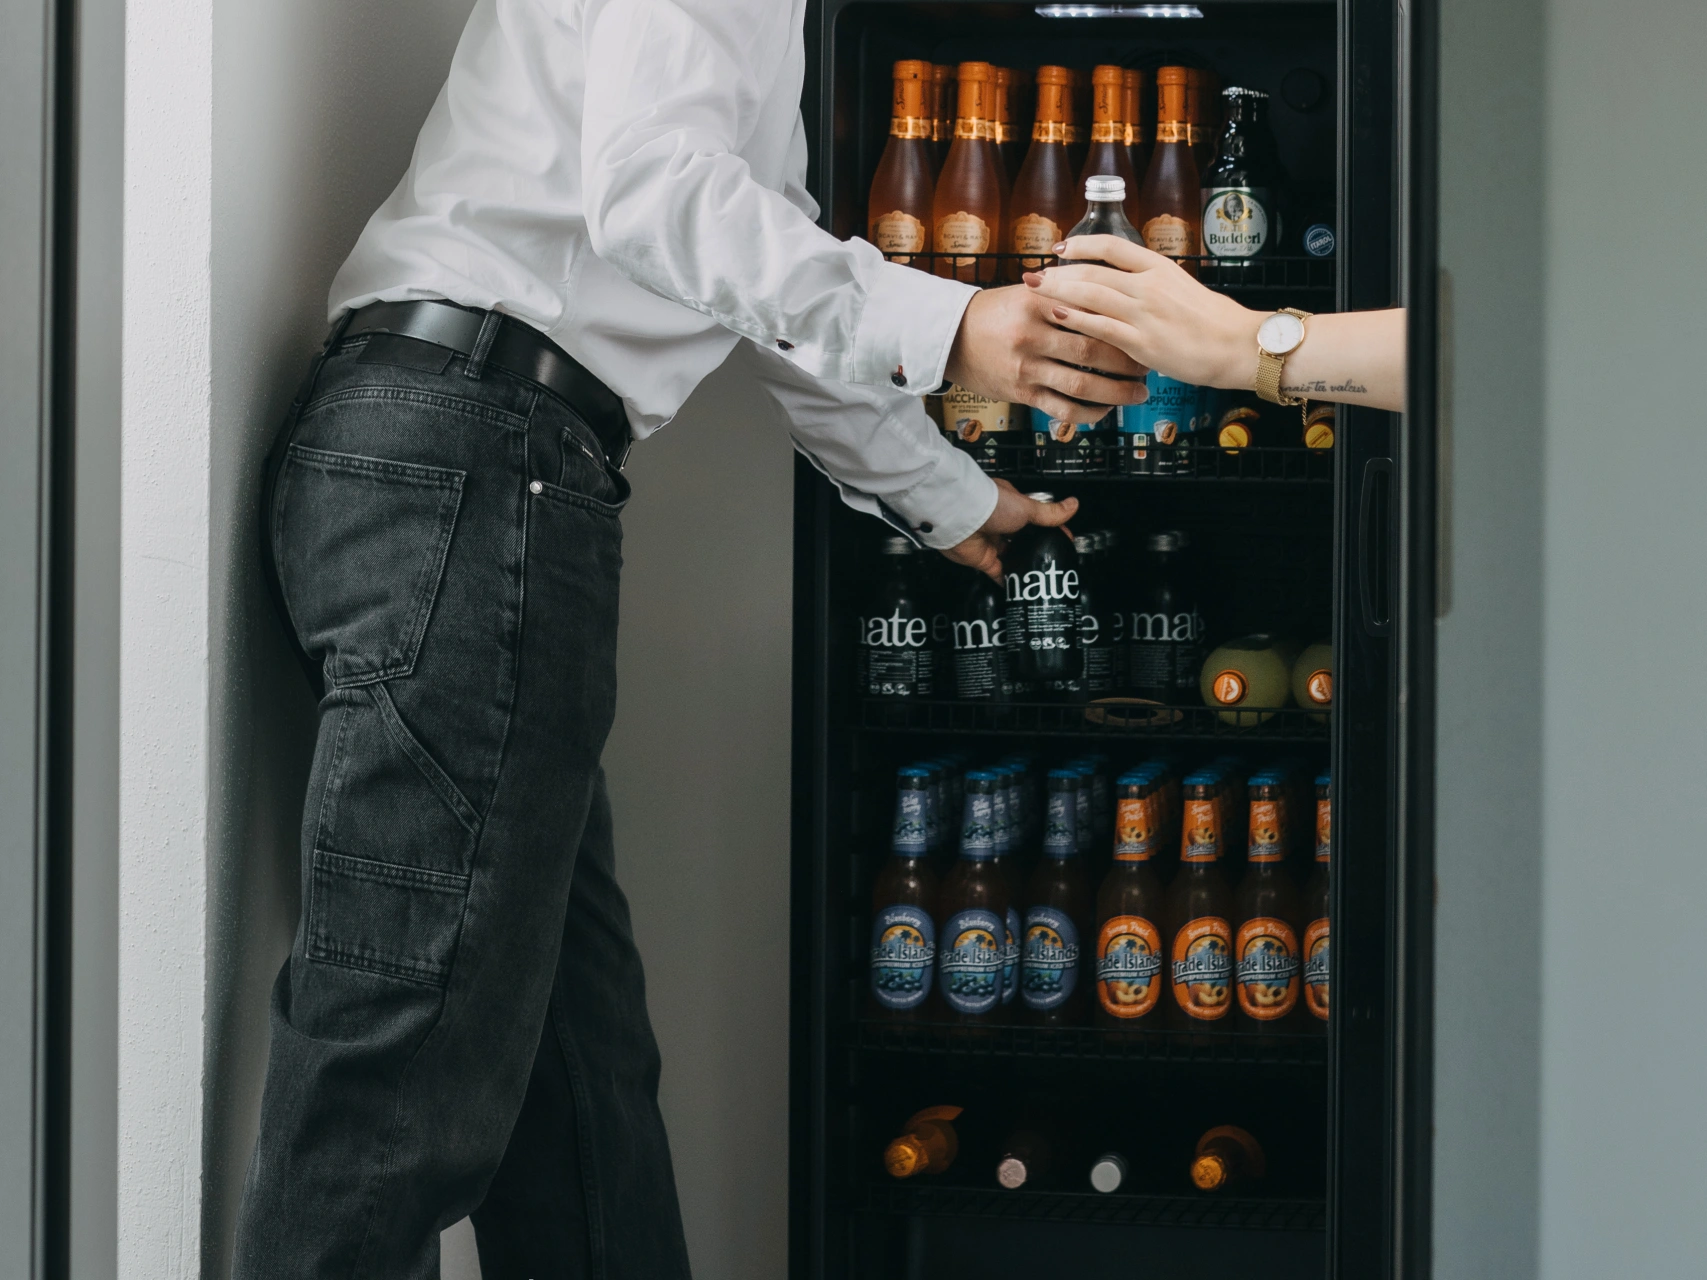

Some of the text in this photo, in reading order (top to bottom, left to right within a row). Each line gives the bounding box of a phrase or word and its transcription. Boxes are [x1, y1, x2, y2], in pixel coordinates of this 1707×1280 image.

[1209, 233, 1261, 245] Budderl
[1156, 387, 1182, 395] LATTE
[1330, 379, 1368, 393] valeur
[1172, 955, 1203, 975] Trade
